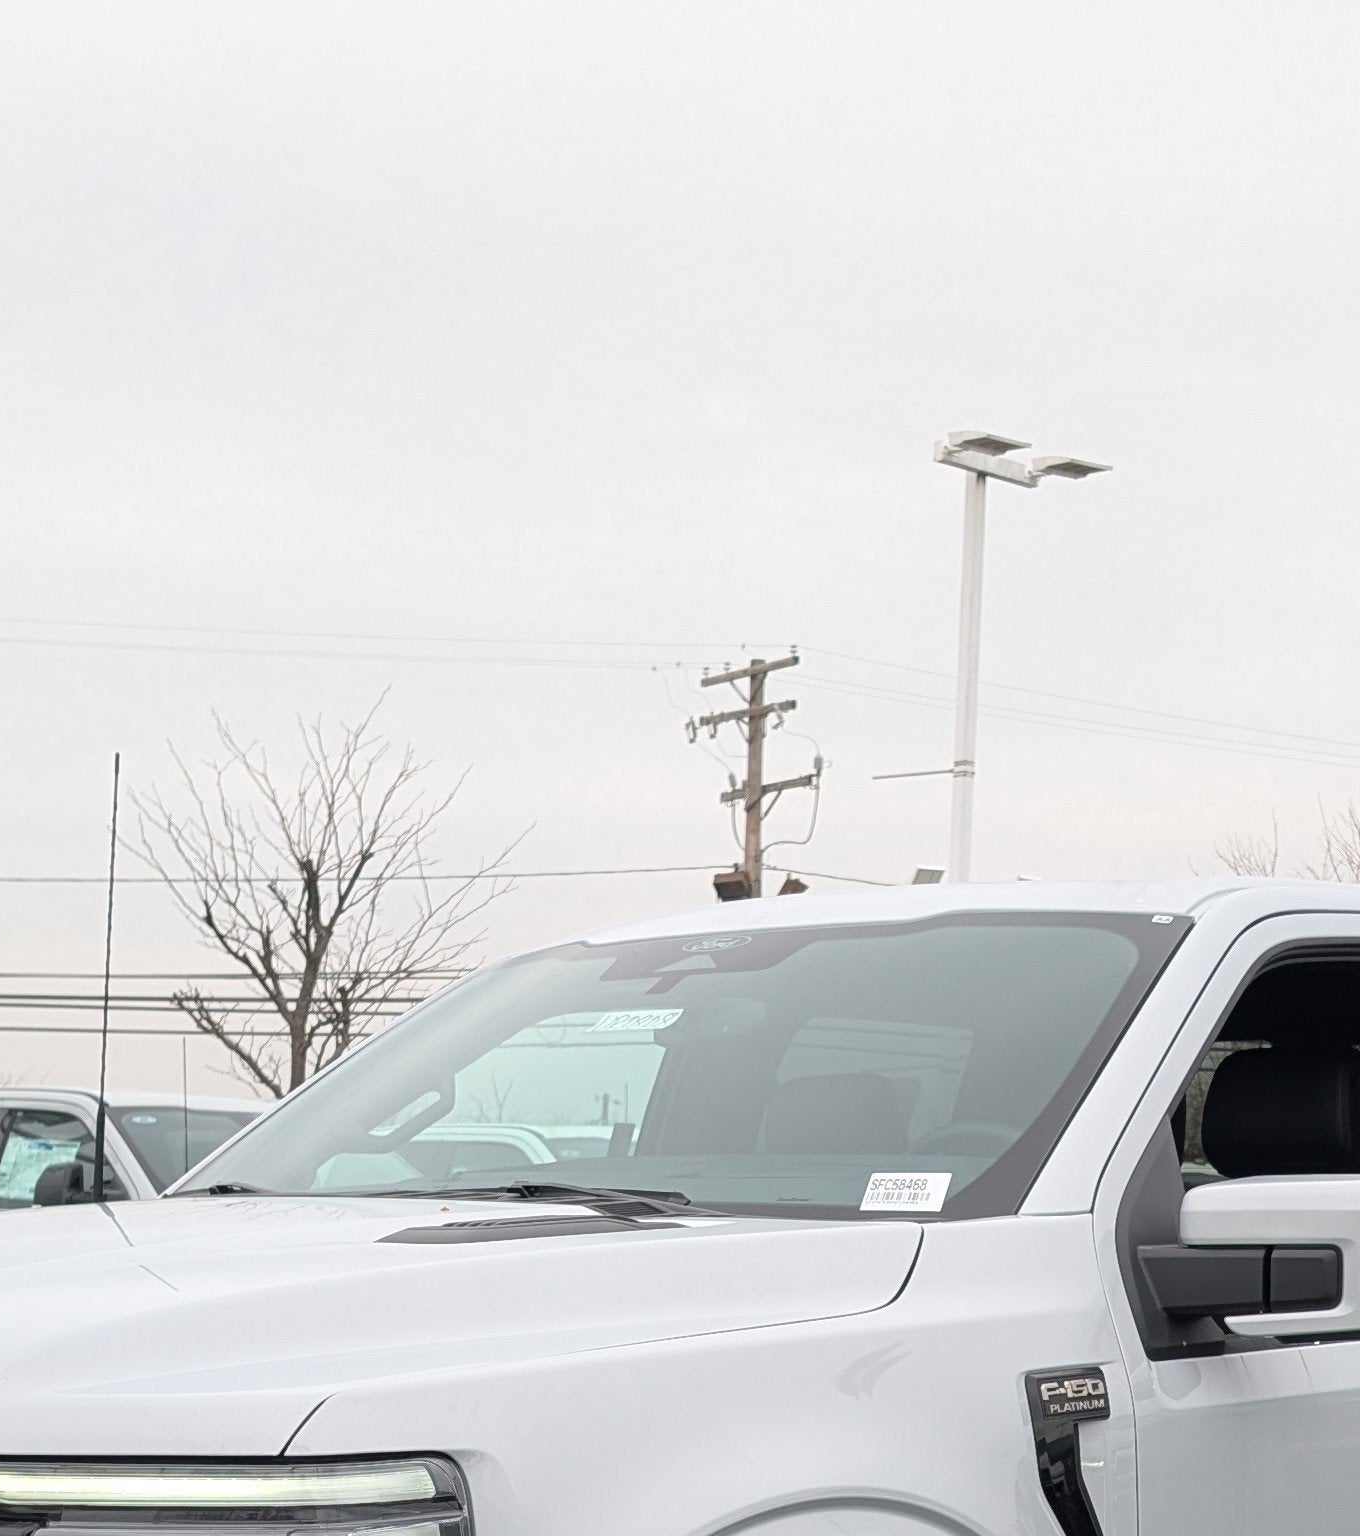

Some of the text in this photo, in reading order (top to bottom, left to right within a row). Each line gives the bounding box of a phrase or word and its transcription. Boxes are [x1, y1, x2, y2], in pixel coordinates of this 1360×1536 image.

[870, 1179, 928, 1191] SFC58468
[1040, 1378, 1105, 1400] F-150
[1049, 1399, 1105, 1413] PLATINUM
